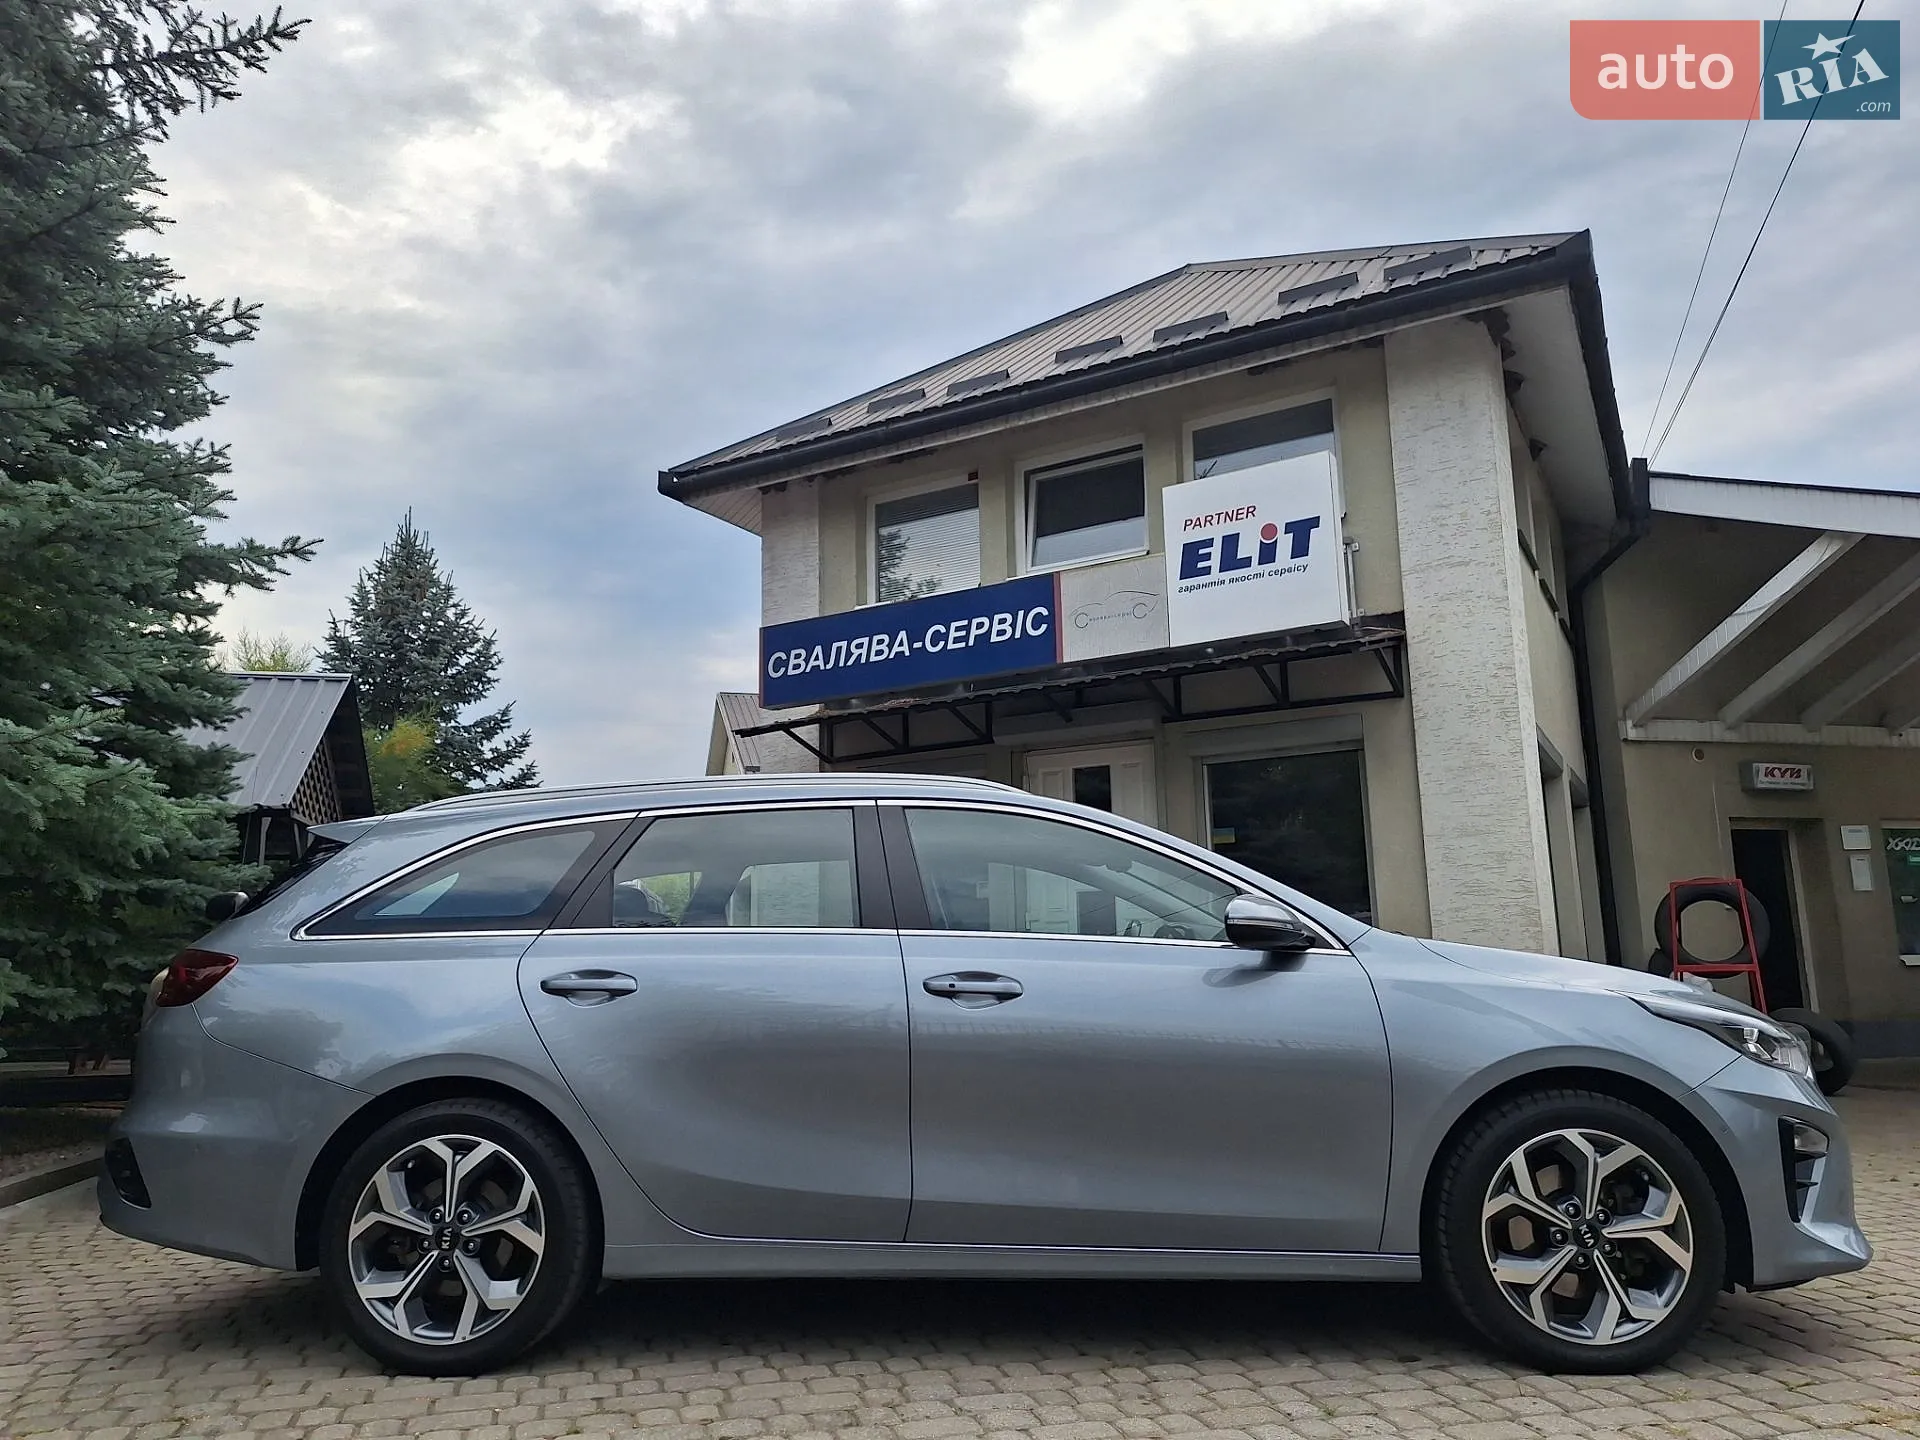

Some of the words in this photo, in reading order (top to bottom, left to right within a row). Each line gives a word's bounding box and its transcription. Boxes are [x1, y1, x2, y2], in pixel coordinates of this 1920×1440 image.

[1183, 504, 1257, 532] PARTNER
[1177, 577, 1226, 594] гарантія
[1228, 570, 1265, 585] якості
[1267, 563, 1309, 577] сервісу
[767, 606, 1049, 678] СВАЛЯВА-СЕРВІС
[441, 1227, 453, 1249] KIA
[1578, 1224, 1594, 1247] KIA
